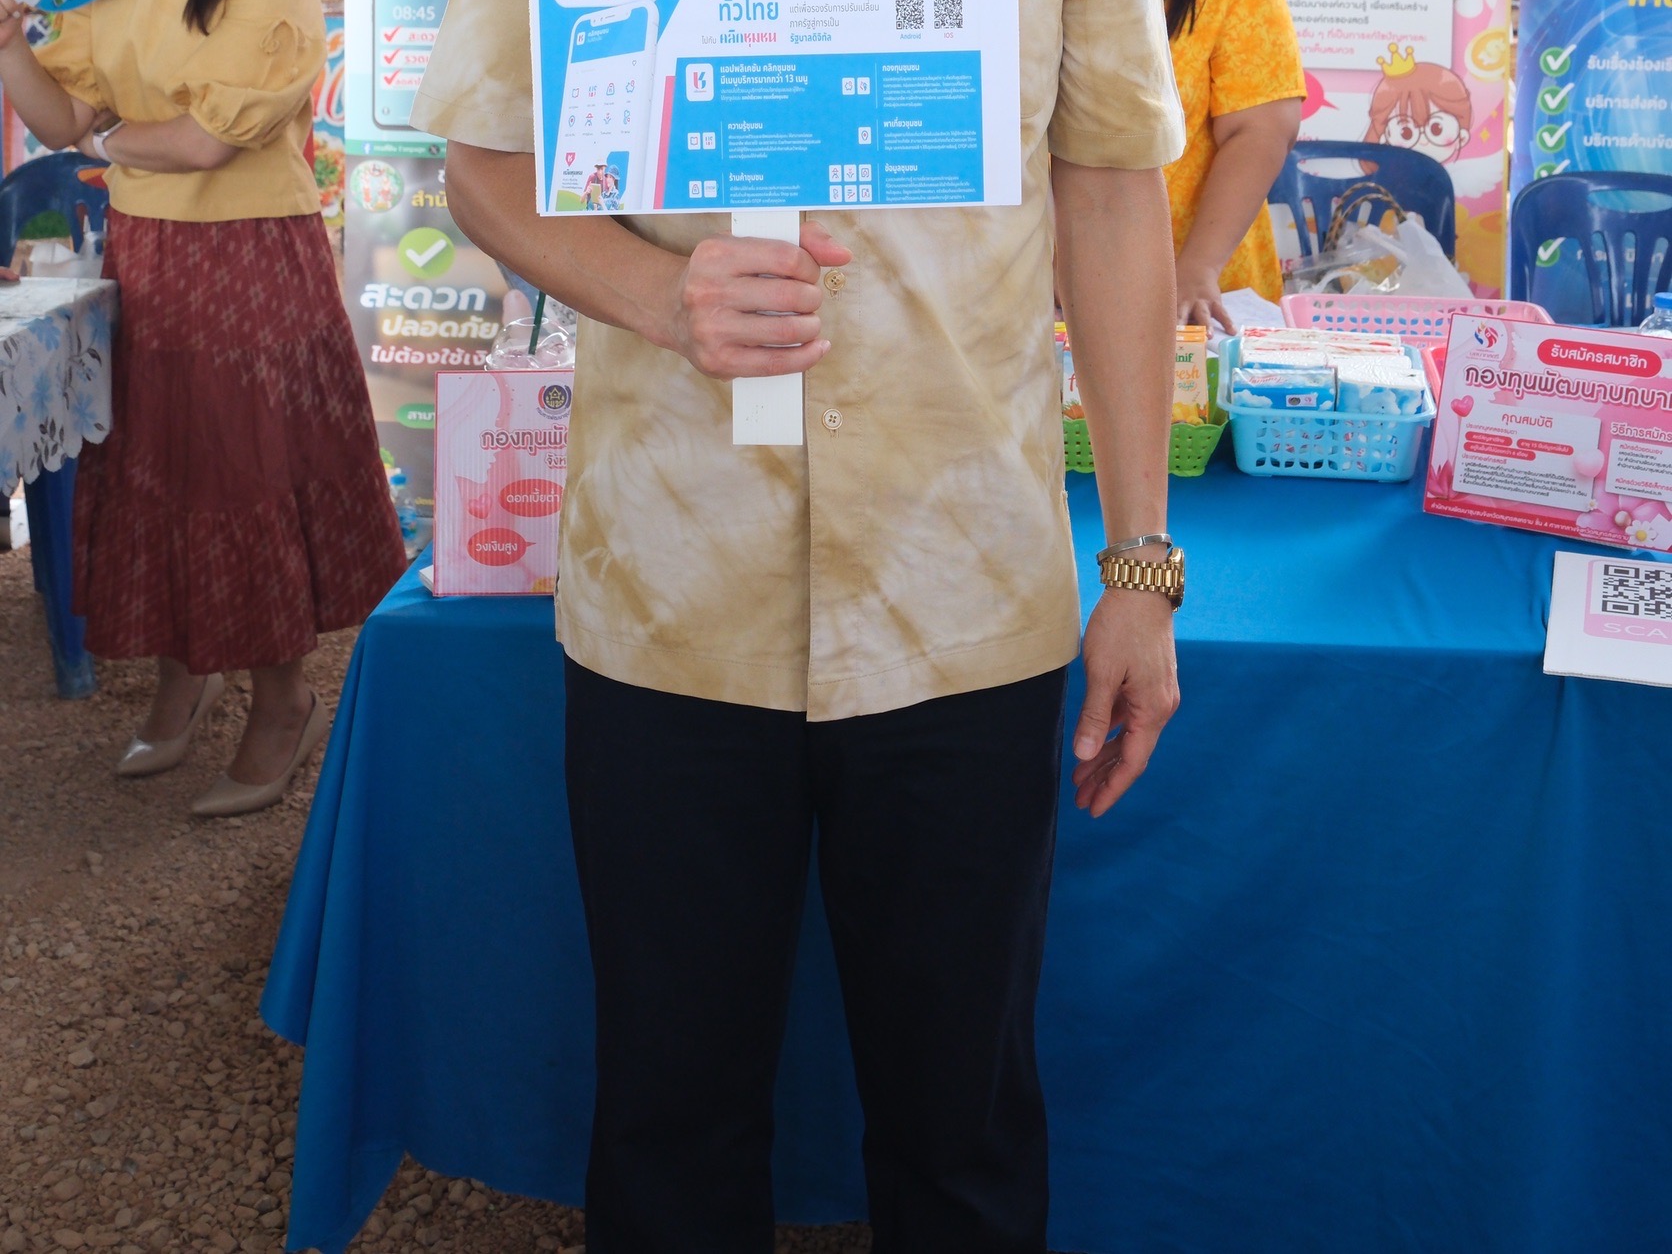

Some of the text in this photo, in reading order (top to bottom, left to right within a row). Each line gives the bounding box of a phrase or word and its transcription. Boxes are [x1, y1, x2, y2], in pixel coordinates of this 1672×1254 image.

[392, 5, 435, 21] 08:45
[719, 29, 777, 47] คลิกชุมชน
[790, 31, 832, 44] รัฐบาลดิจิทัล
[900, 32, 921, 40] Android
[720, 63, 796, 74] แอปพลิเคชัน คลิกชุมชน
[882, 64, 920, 74] กองทุนชุมชน
[785, 74, 794, 83] 13
[885, 163, 918, 174] ข้อมูลชุมชน
[729, 172, 764, 183] ร้านค้าชุมชน
[360, 282, 487, 311] สะดวก
[382, 315, 499, 339] ปลอดภัย
[1551, 343, 1648, 370] รับสมัครสมาชิก
[1501, 413, 1553, 429] คุณสมบัติ
[507, 488, 560, 503] ดอกเบี้ยต่ำ
[475, 539, 517, 555] วงเงินสูง
[1602, 622, 1668, 639] SCA
